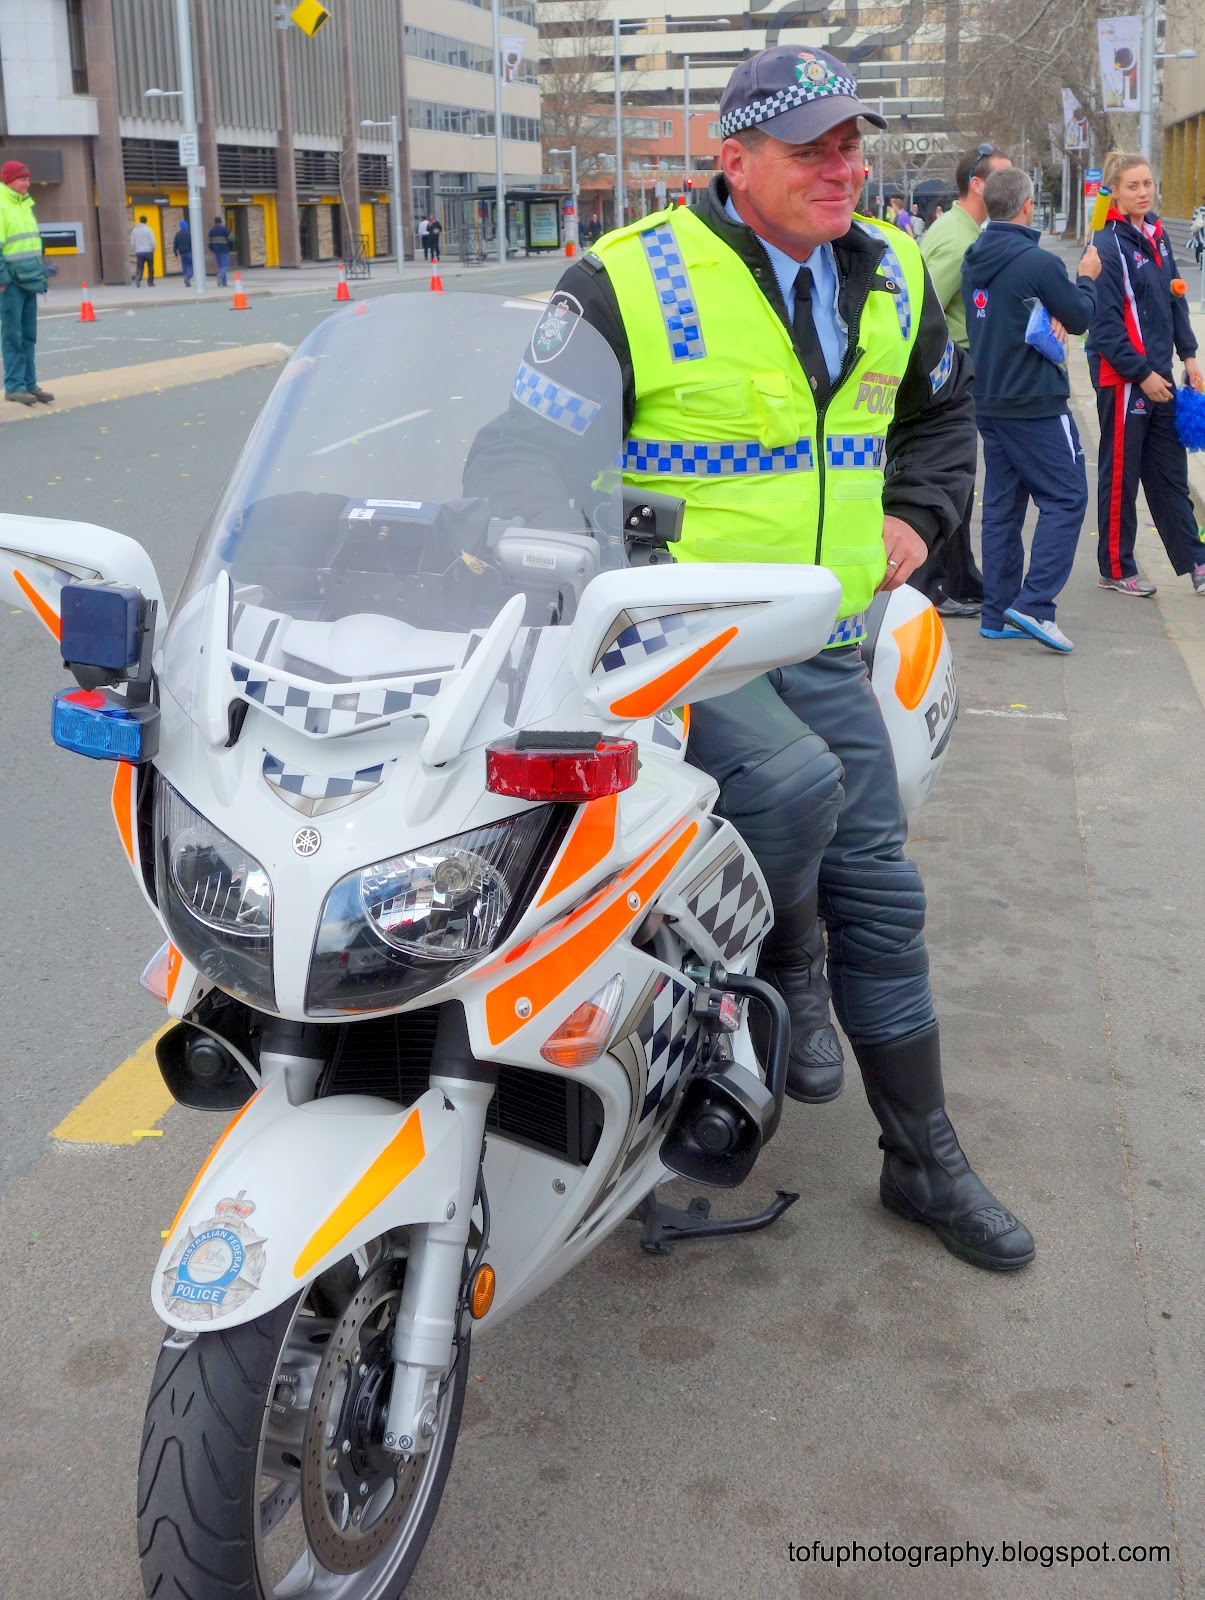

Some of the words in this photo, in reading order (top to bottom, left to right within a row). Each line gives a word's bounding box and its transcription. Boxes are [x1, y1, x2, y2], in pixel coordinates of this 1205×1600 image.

[861, 136, 945, 153] LONDON
[976, 309, 986, 318] AIS
[853, 382, 897, 416] POLIC
[180, 1230, 228, 1266] AUSTRALIAN
[227, 1235, 242, 1273] FEDERAL
[175, 1284, 221, 1302] POLICE
